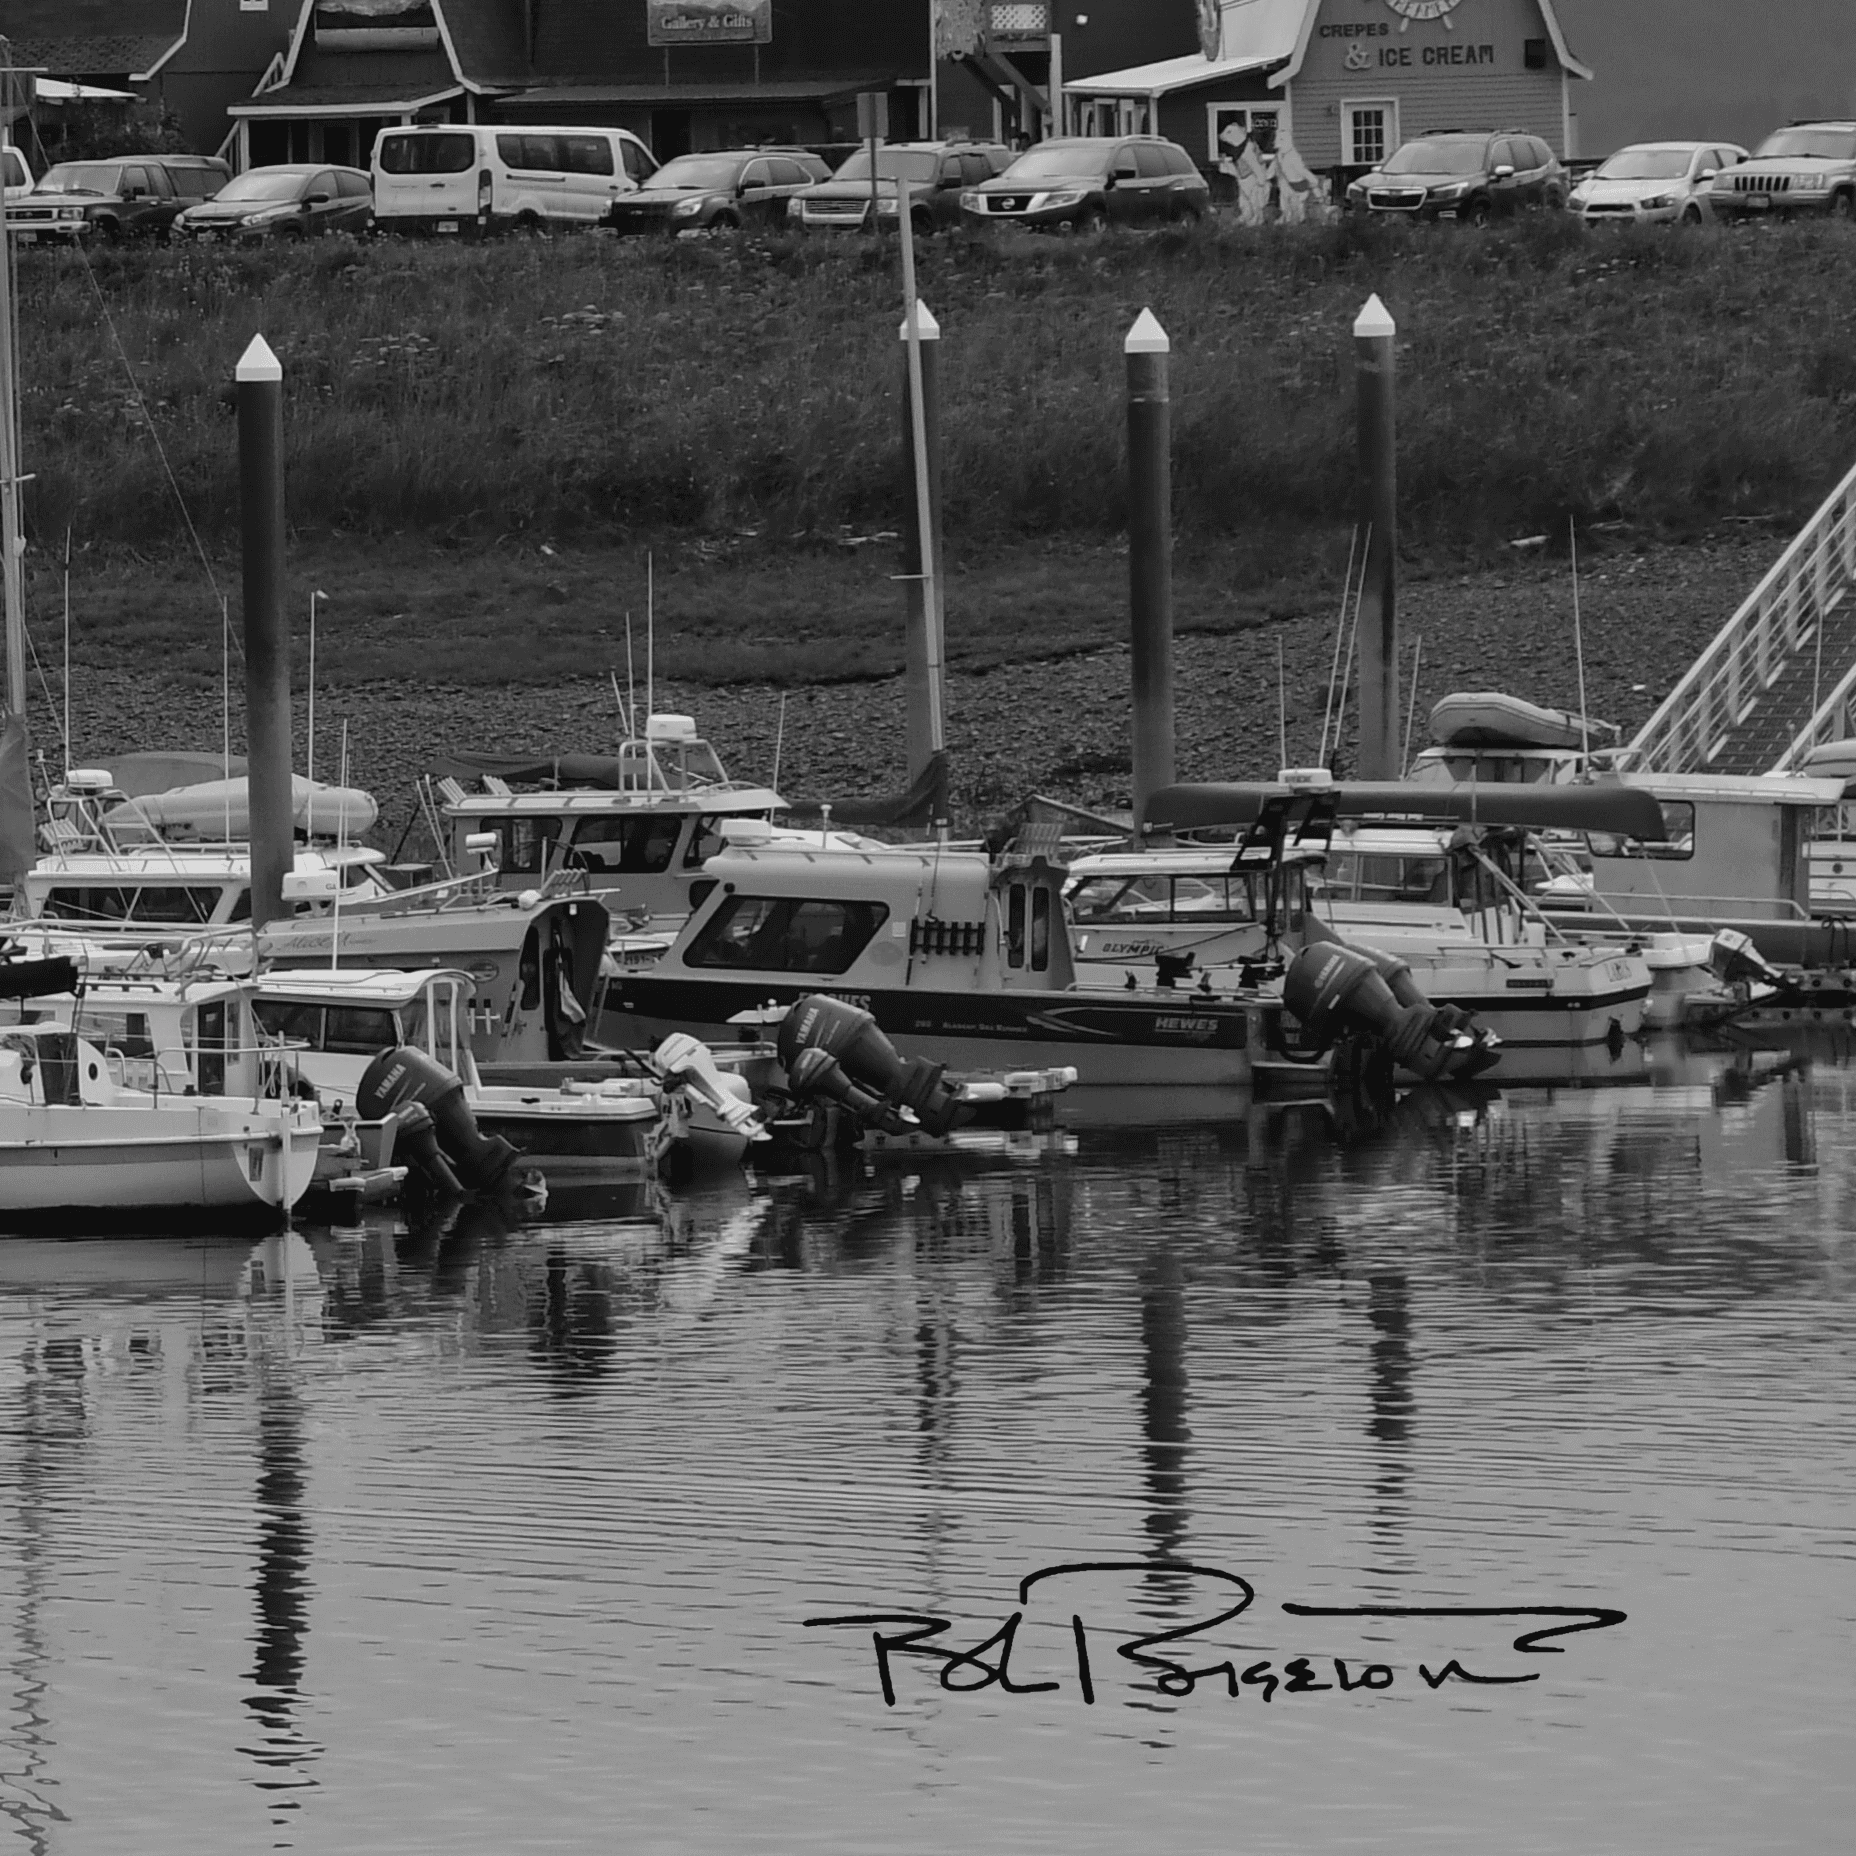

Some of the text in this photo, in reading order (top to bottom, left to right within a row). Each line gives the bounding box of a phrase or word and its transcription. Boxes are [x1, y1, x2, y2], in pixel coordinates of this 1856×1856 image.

[661, 13, 754, 31] Gallery & Gifts
[1319, 22, 1389, 39] CREPES
[1344, 42, 1495, 71] & ICE CREAM
[796, 1007, 820, 1045] YAMAHA
[1155, 1017, 1219, 1031] HEWES
[374, 1063, 407, 1099] YAMAHA
